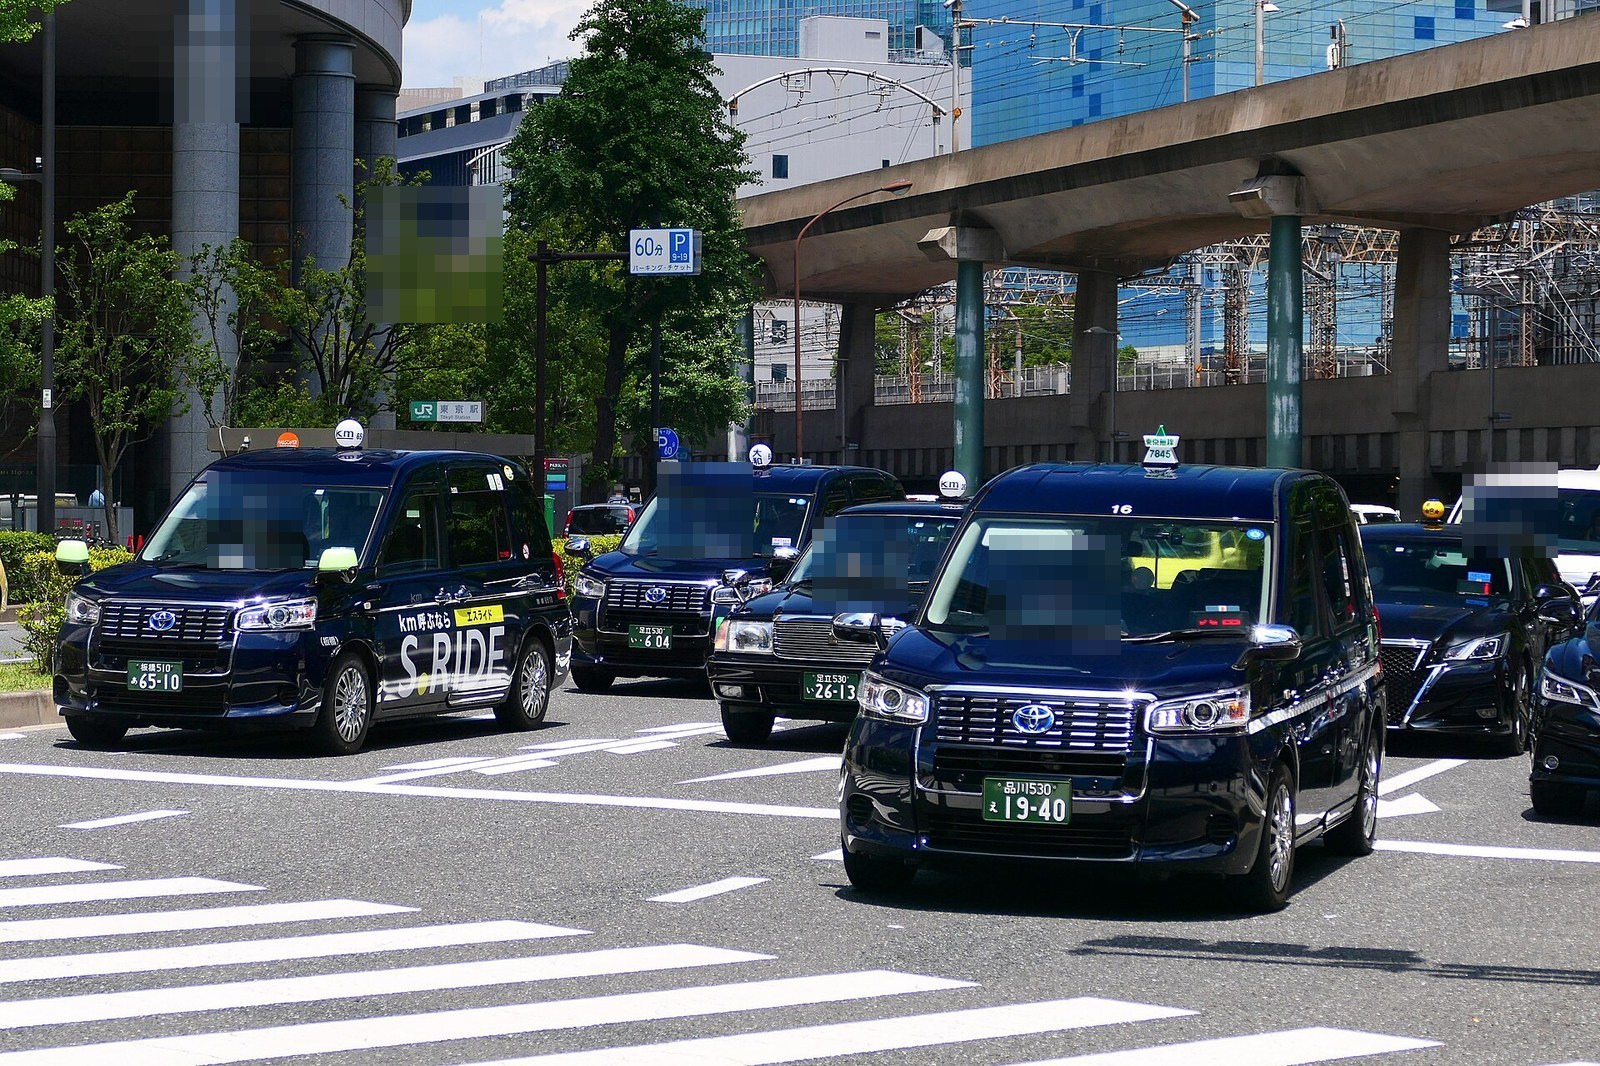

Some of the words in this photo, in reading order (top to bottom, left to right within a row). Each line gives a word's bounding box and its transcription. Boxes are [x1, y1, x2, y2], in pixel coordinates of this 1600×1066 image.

[635, 237, 663, 256] 60分
[675, 233, 686, 251] P
[672, 253, 688, 261] 9-19
[414, 404, 433, 415] JR
[440, 404, 479, 414] 東京駅
[336, 430, 354, 439] km
[752, 448, 763, 465] 大和
[1149, 449, 1171, 458] 7845
[941, 480, 959, 490] km
[1111, 504, 1133, 514] 16
[467, 609, 492, 622] エスライド
[398, 612, 451, 632] km呼ぶなら
[140, 663, 171, 673] 板橋510
[139, 673, 180, 690] 65-10
[816, 673, 847, 684] 足立530
[815, 683, 856, 700] 26-13
[1004, 781, 1052, 796] 品川530
[1005, 796, 1066, 822] 19-40
